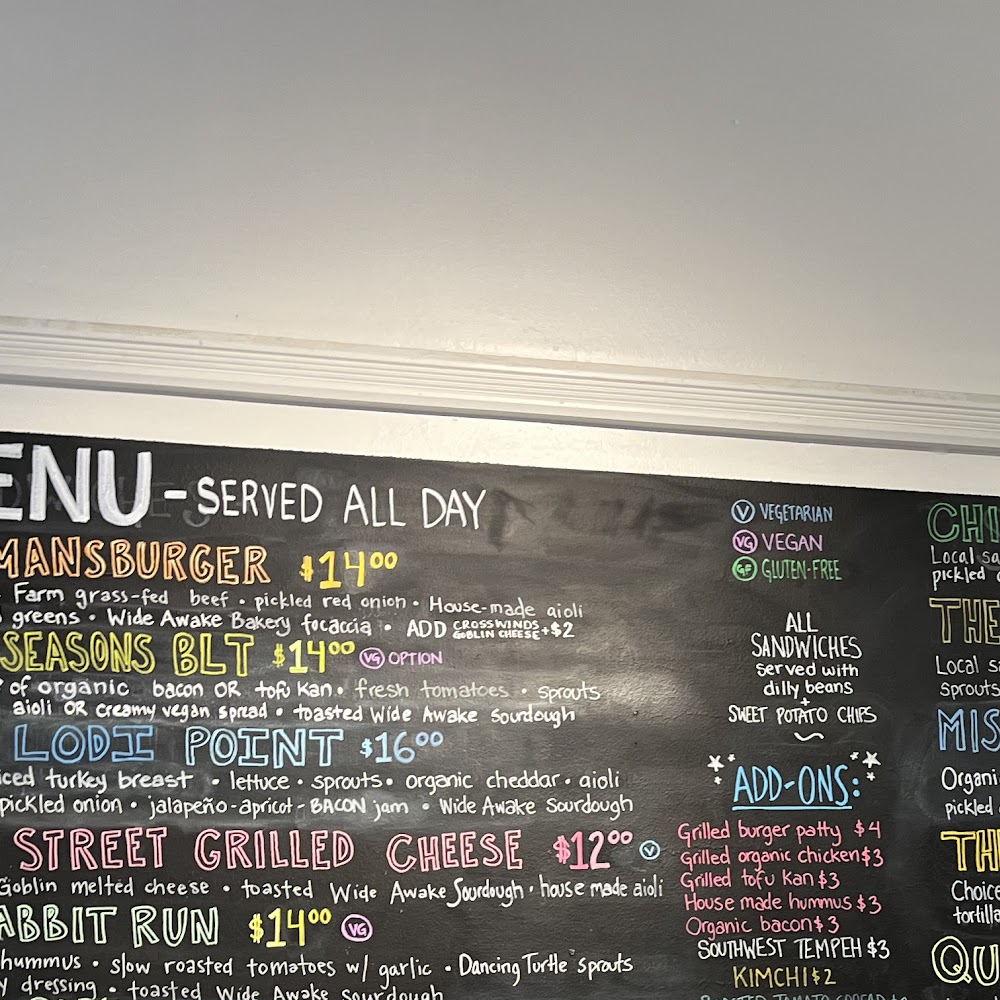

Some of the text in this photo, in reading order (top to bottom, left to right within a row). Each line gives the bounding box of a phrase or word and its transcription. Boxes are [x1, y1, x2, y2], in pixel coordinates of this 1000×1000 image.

[197, 475, 323, 523] SERVED
[343, 484, 407, 528] ALL
[421, 487, 487, 530] DAY
[759, 502, 834, 524] VEGETARIAN
[761, 532, 823, 551] VEGAN
[760, 558, 843, 583] GLUTEN-FREE
[13, 581, 584, 619] Farm grass-fed beef pickled red onion House-made aioli
[406, 619, 447, 640] ADD
[452, 619, 540, 630] CROSSWINDS
[785, 611, 819, 633] ALL
[452, 629, 541, 641] GOBLIN CHEESE
[750, 632, 863, 660] SANDWICHES
[0, 630, 255, 677] SEASONS BLT
[387, 650, 443, 666] OPTION
[755, 662, 859, 677] served with
[763, 680, 854, 700] dilly beans
[728, 704, 878, 725] SWEET POTATO CHIPS
[14, 723, 345, 769] LODI POINT
[677, 820, 731, 848] Grilled
[738, 820, 791, 846] burger
[796, 821, 842, 847] patty
[697, 937, 891, 960] SOUTHWEST TEMPEH $3
